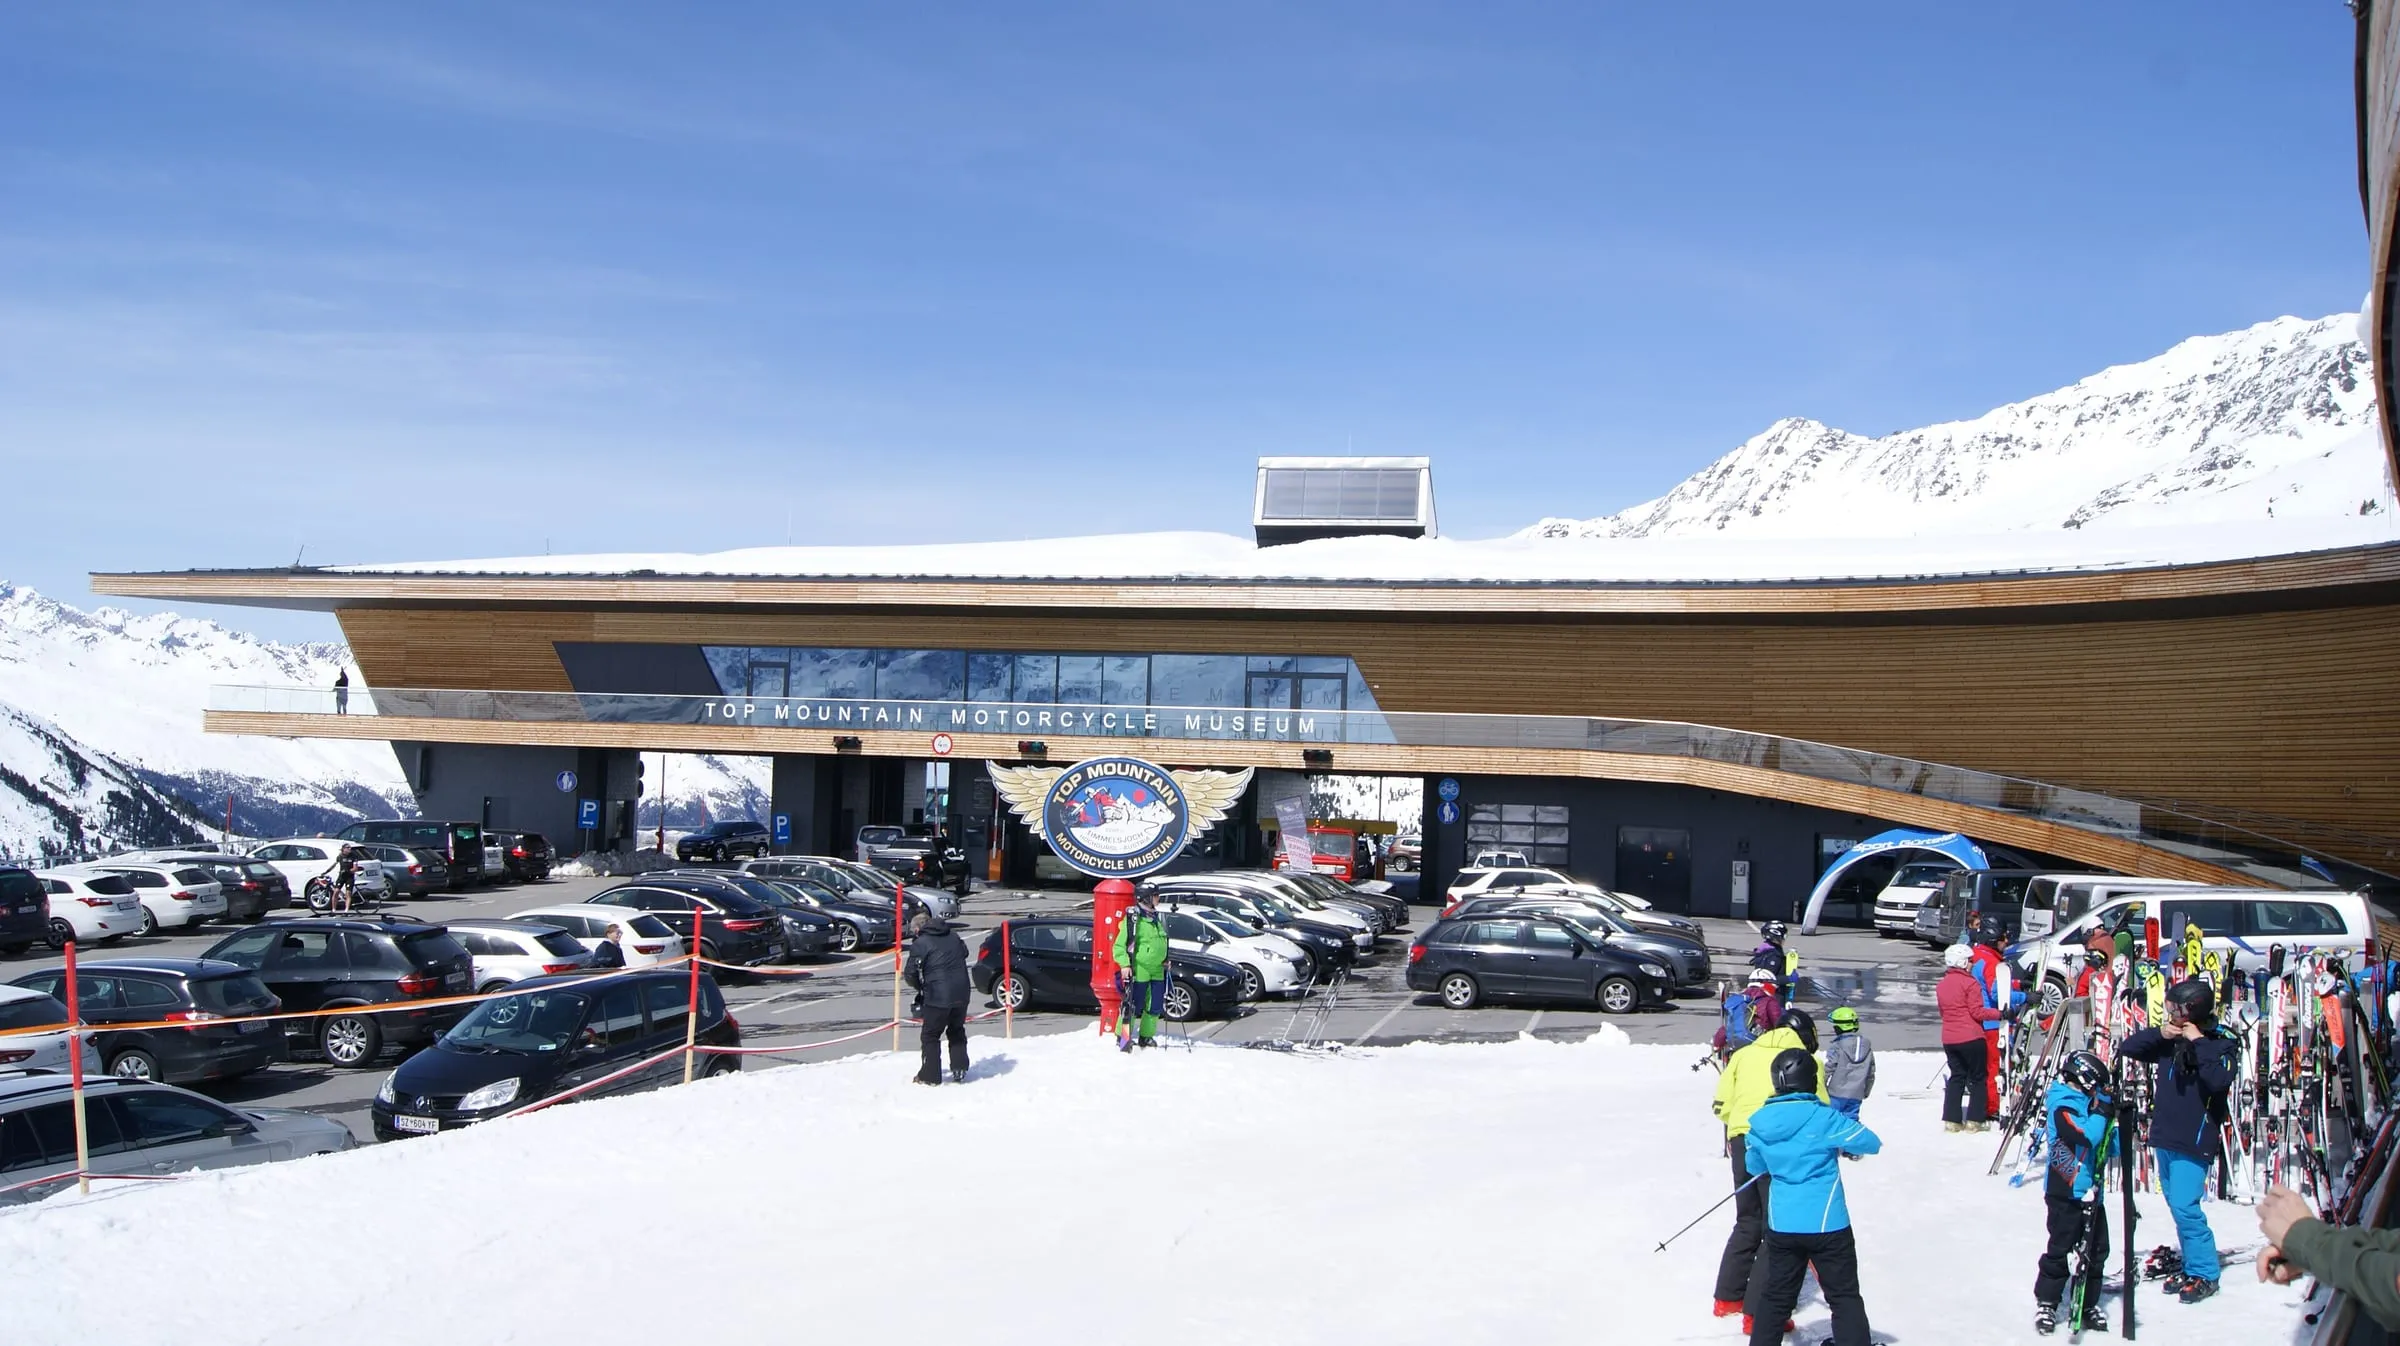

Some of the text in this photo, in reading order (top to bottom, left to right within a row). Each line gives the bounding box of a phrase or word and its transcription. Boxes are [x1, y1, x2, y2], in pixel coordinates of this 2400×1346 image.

[705, 702, 1315, 734] TOP MOUNTAIN MOTORCYCLE MUSEUM
[1053, 762, 1179, 807] TOP MOUNTAIN
[583, 801, 597, 818] P
[776, 815, 788, 833] P
[1055, 832, 1175, 871] MOTORCYCLE MUSEUM
[1852, 841, 1895, 854] Sport
